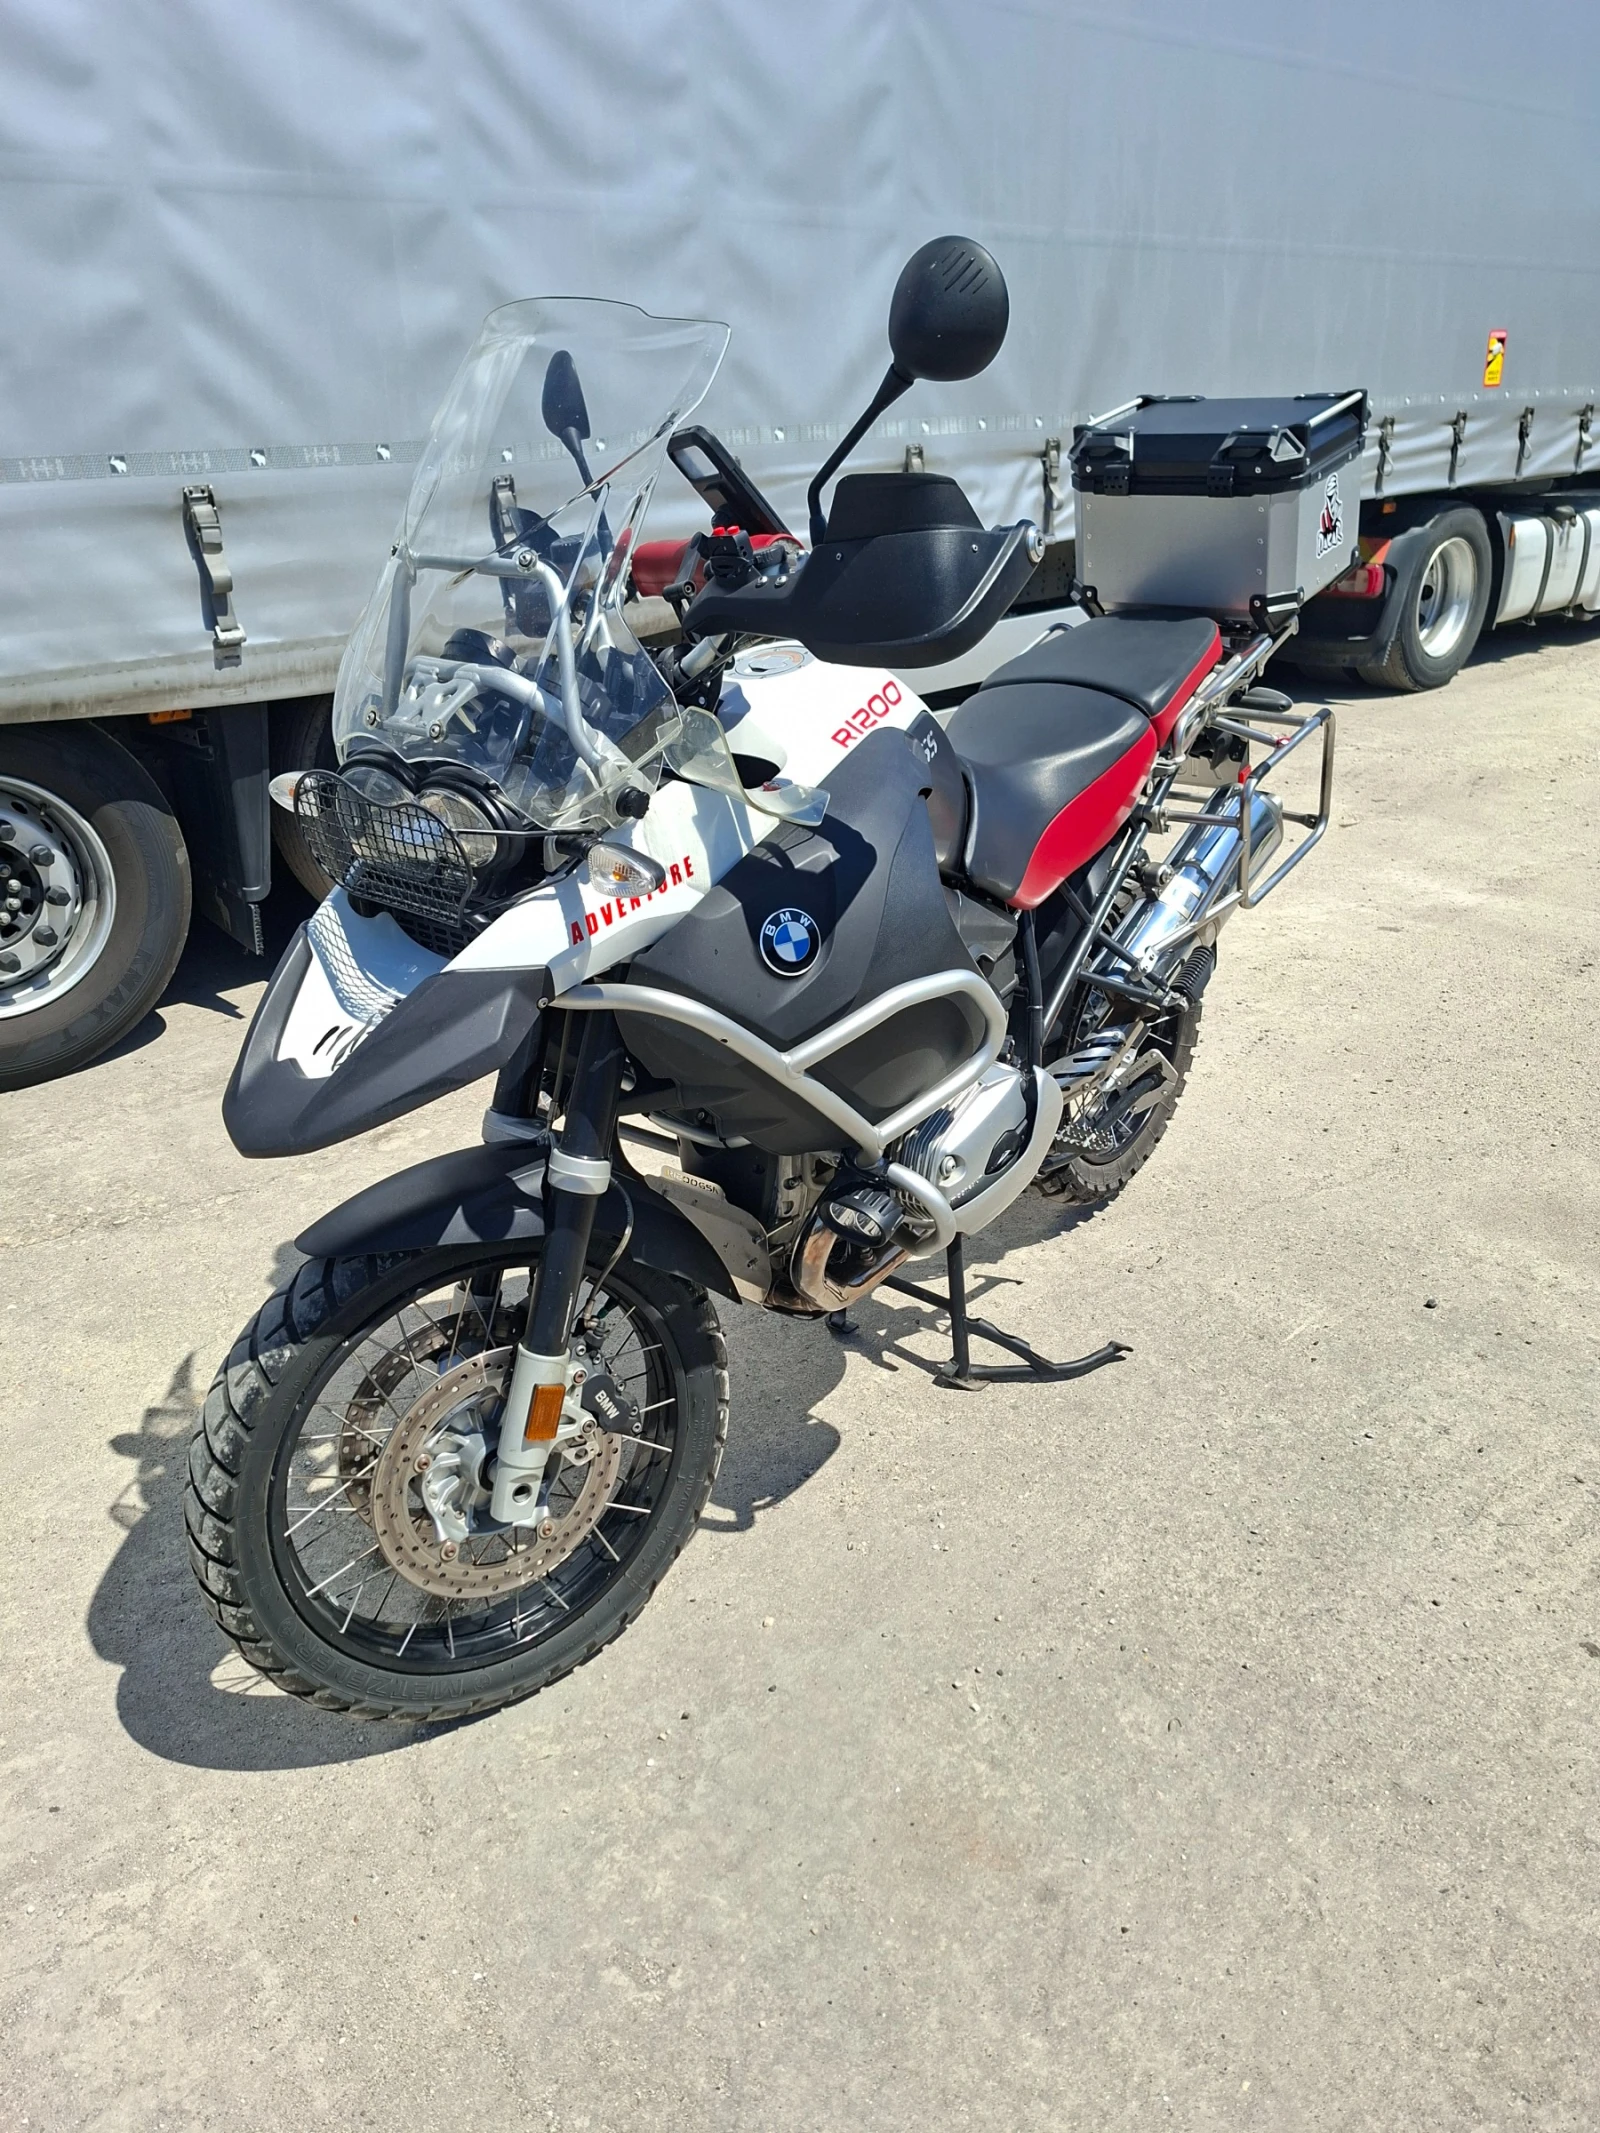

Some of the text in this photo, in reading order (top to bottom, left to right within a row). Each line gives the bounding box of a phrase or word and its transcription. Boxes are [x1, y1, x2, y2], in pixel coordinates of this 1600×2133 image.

[830, 680, 902, 749] R1200
[765, 911, 811, 937] BMW
[90, 948, 152, 1023] KMAX
[594, 1389, 620, 1420] BMW
[294, 1635, 465, 1701] METZELER
